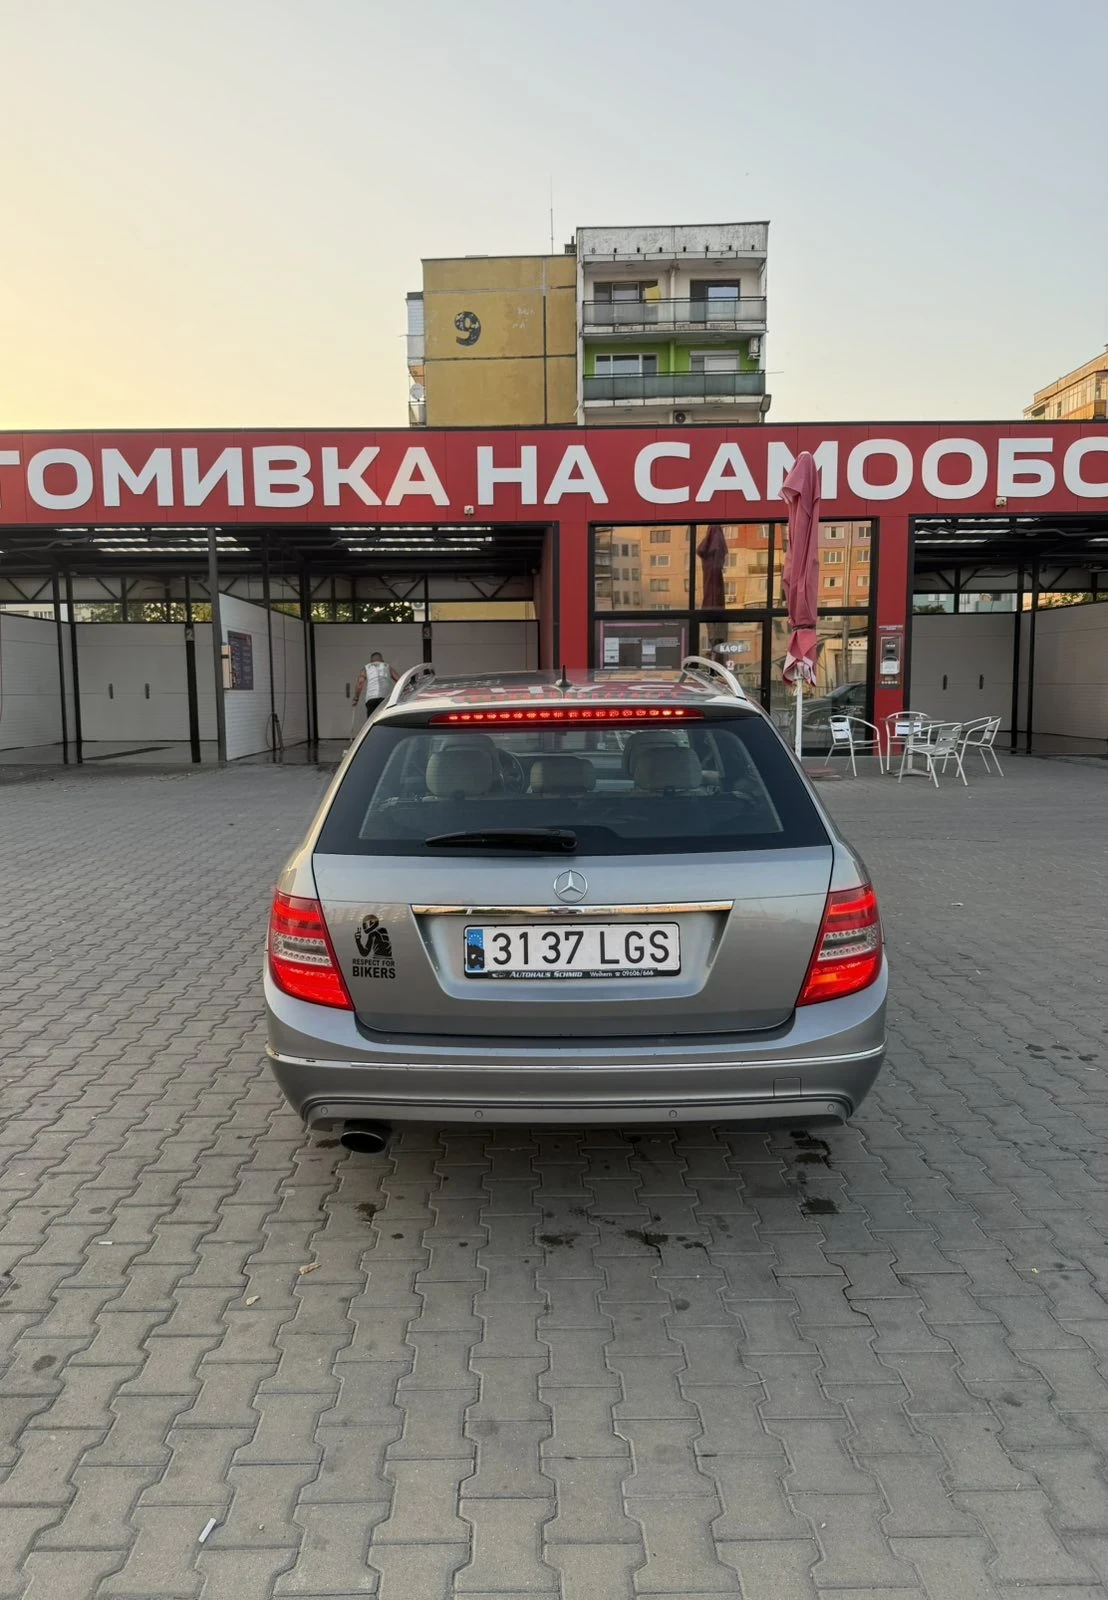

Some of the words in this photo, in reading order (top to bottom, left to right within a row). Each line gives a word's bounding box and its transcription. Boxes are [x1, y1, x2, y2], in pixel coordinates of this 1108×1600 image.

[455, 311, 482, 347] 9
[477, 444, 609, 505] НА
[352, 958, 380, 966] RESPECT
[492, 931, 584, 965] 3137
[600, 930, 669, 964] LGS
[352, 966, 396, 979] BIKERS
